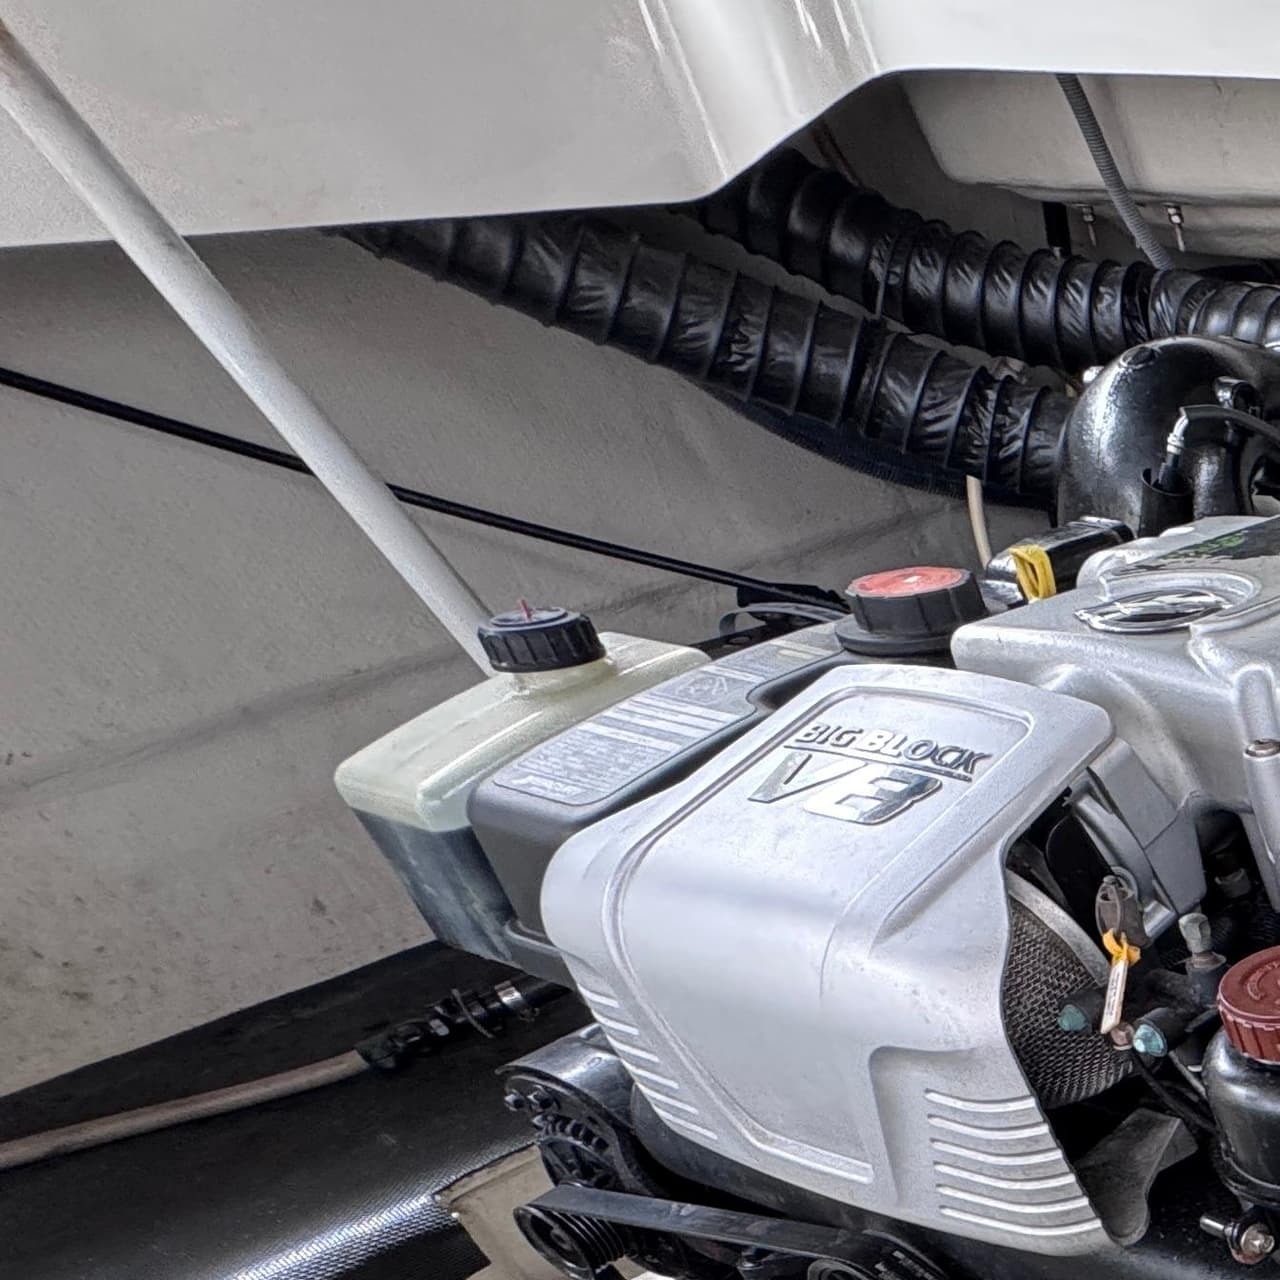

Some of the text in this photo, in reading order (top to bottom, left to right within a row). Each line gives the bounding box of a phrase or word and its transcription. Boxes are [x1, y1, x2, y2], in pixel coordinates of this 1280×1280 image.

[794, 722, 993, 775] BIG BLOCK
[747, 752, 943, 826] V8
